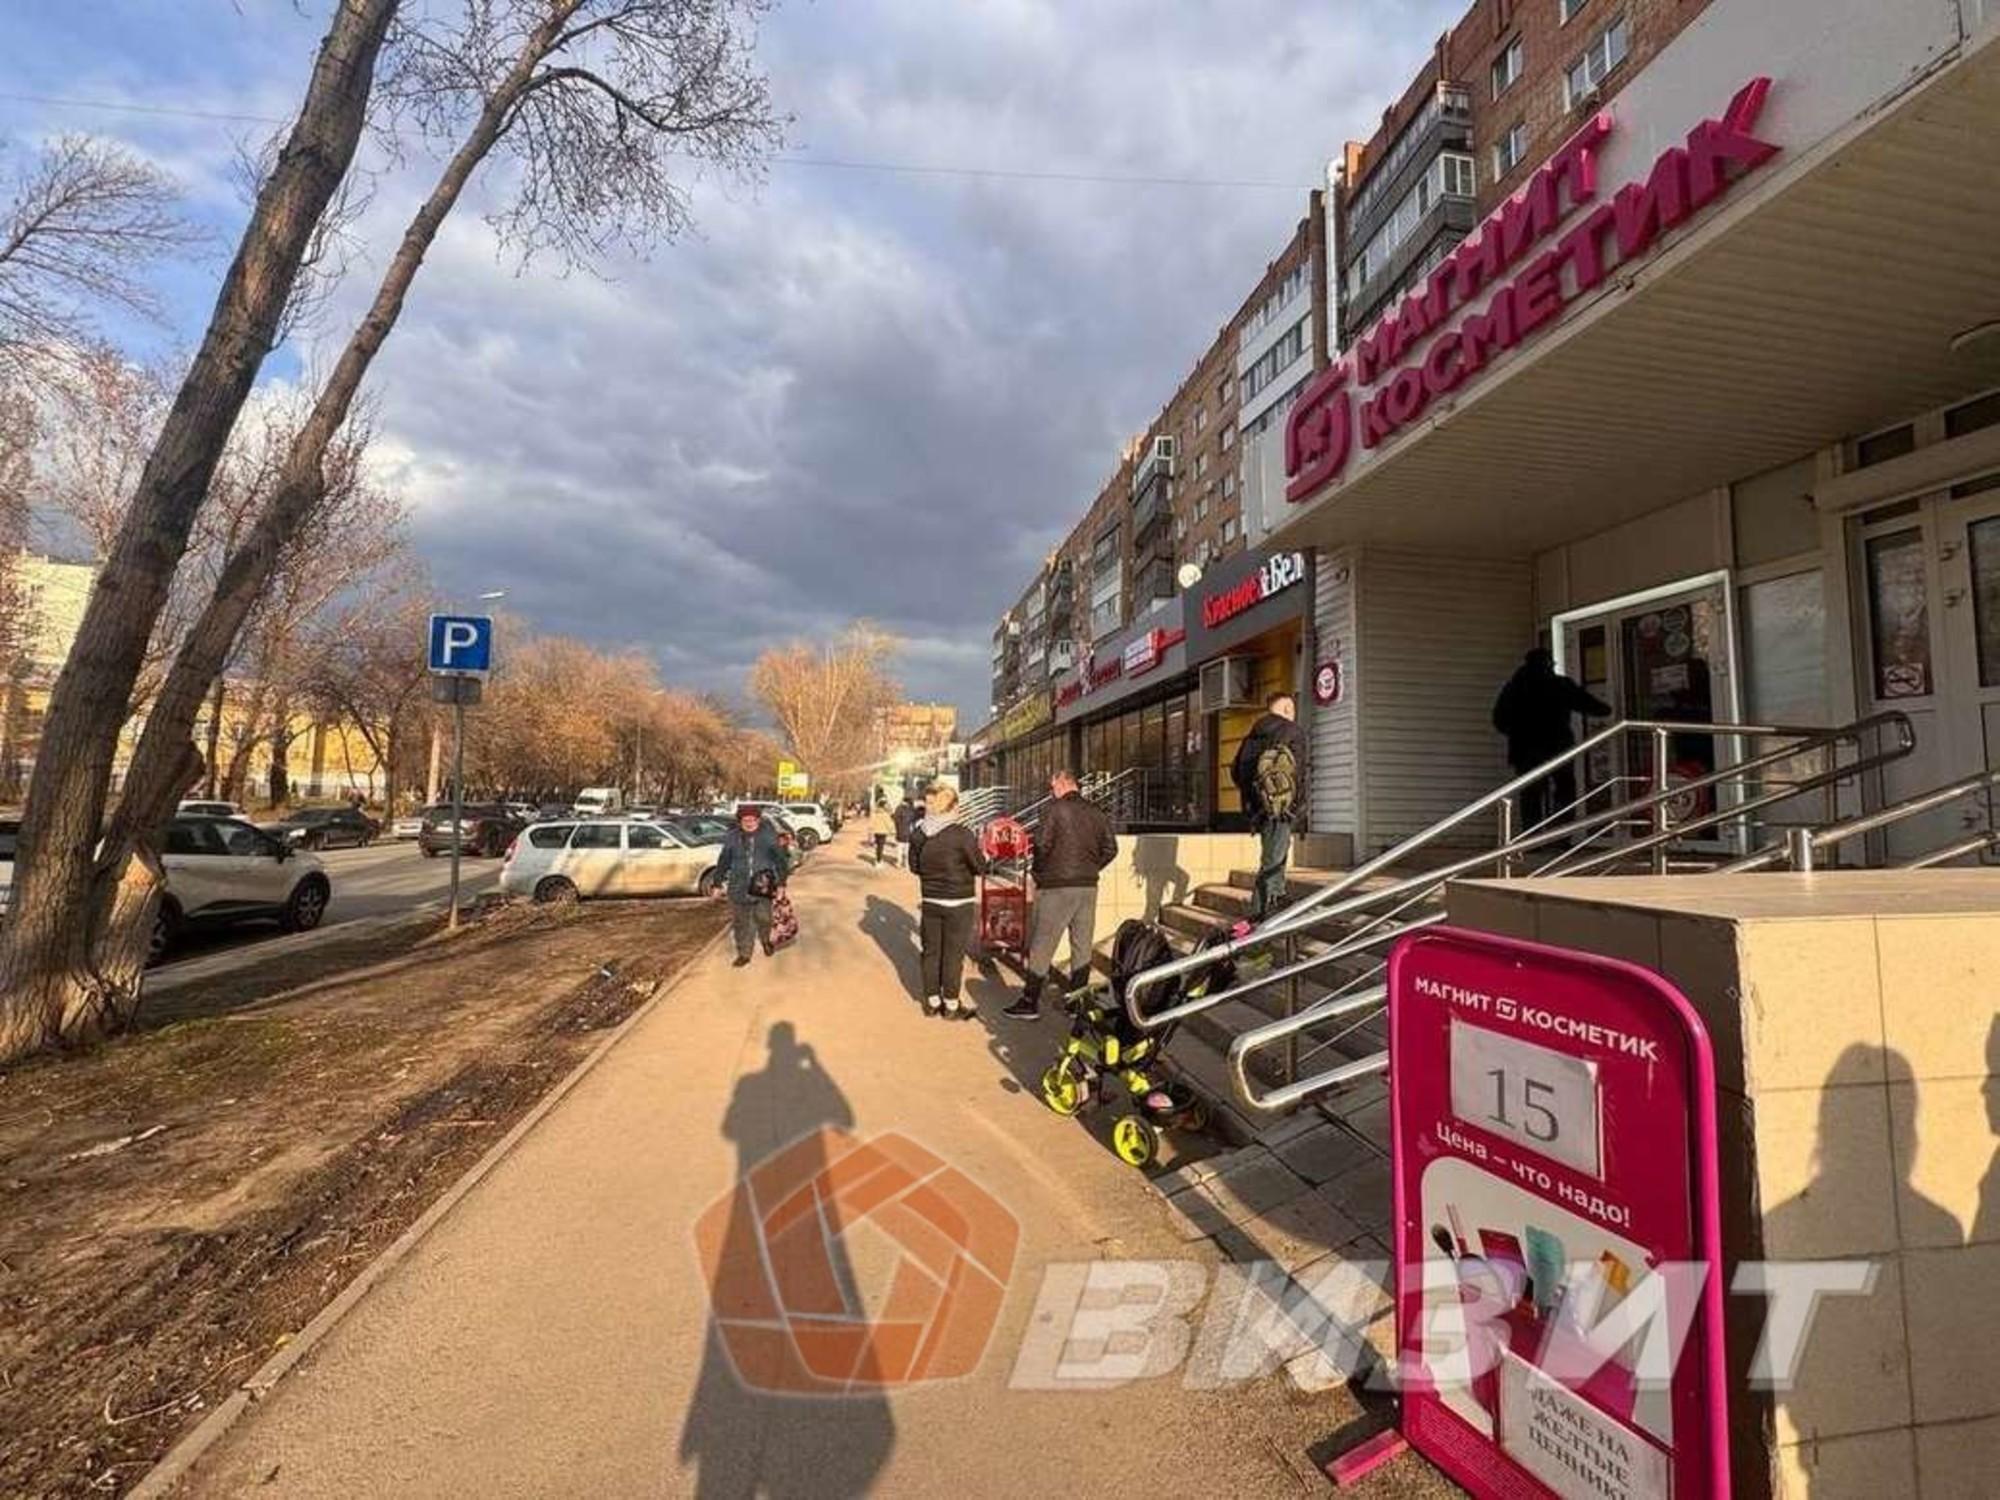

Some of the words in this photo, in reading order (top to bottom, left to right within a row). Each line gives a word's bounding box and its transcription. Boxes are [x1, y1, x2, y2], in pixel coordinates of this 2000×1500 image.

[1355, 111, 1615, 387] МАГНИТ
[1360, 76, 1784, 451] КОСМЕТИК
[443, 620, 479, 664] P
[1414, 976, 1490, 1012] МАГНИТ
[1521, 1005, 1660, 1062] КОСМЕТИК
[1486, 1068, 1560, 1143] 15
[1436, 1122, 1488, 1161] Цена
[1511, 1162, 1551, 1190] что
[1558, 1180, 1631, 1228] надо!
[1533, 1411, 1631, 1489] ЖЕЛТЫЕ
[1597, 1427, 1630, 1463] НА
